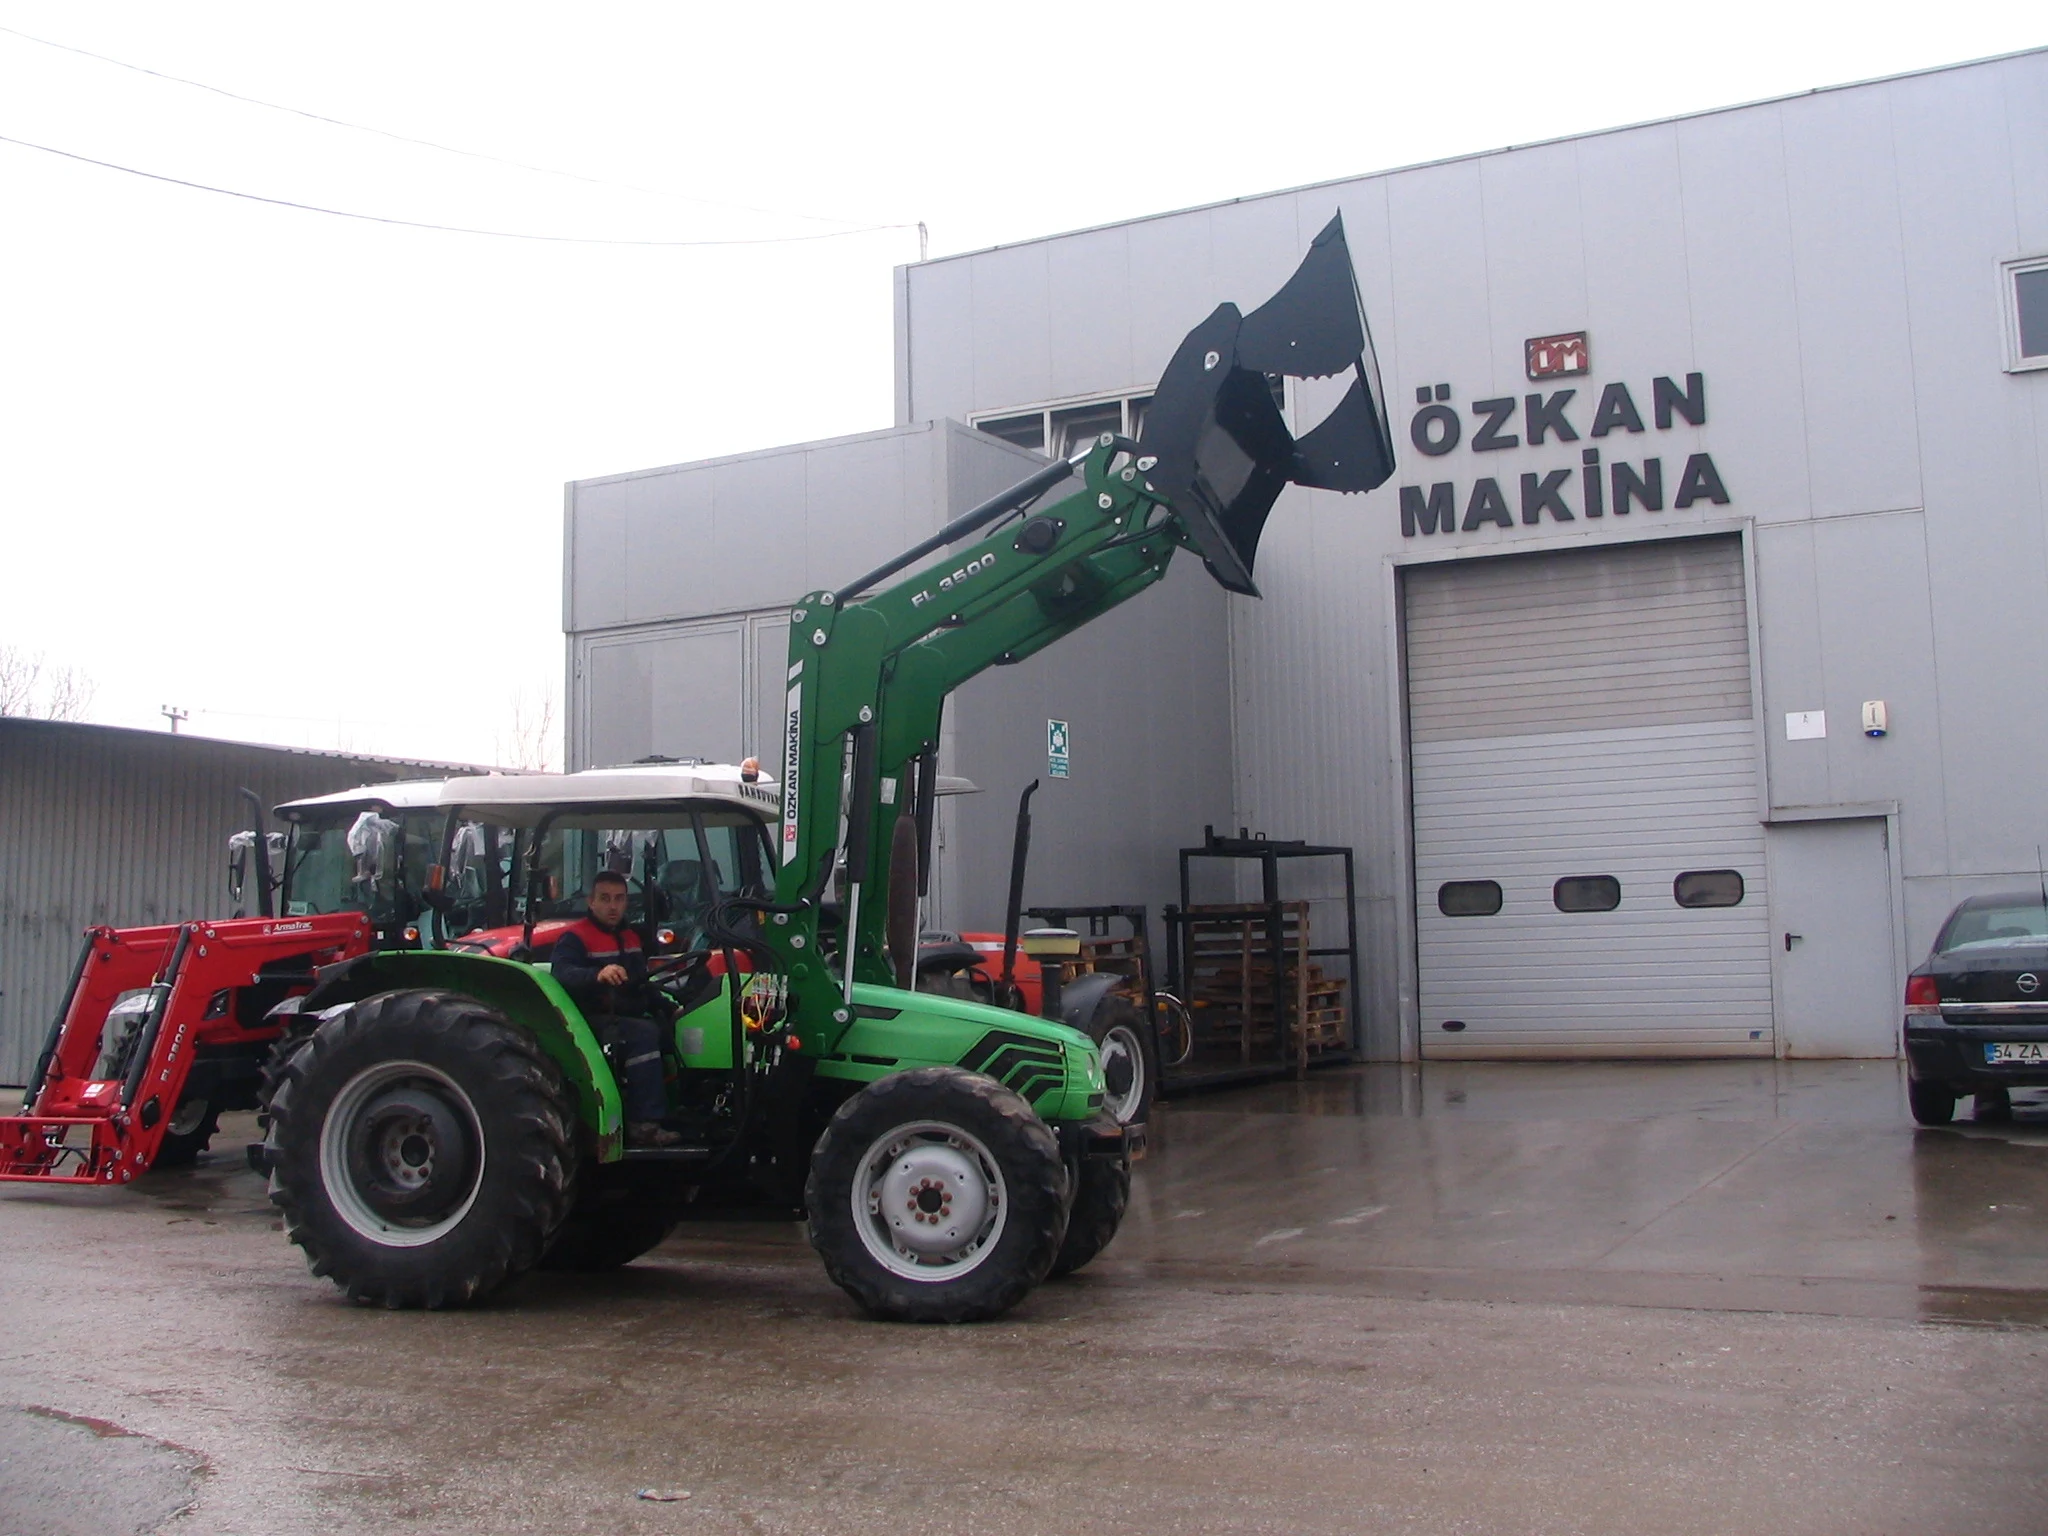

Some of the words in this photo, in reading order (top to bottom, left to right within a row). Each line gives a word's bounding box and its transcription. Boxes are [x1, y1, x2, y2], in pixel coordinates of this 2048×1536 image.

[1411, 372, 1706, 456] ÖZKAN
[1399, 448, 1731, 537] MAKİNA
[911, 590, 936, 608] FL
[939, 553, 996, 592] 3500
[788, 710, 798, 766] MAKİNA
[274, 922, 312, 932] ArmaTrac
[1993, 1044, 2012, 1058] 54
[2018, 1044, 2042, 1058] ZA
